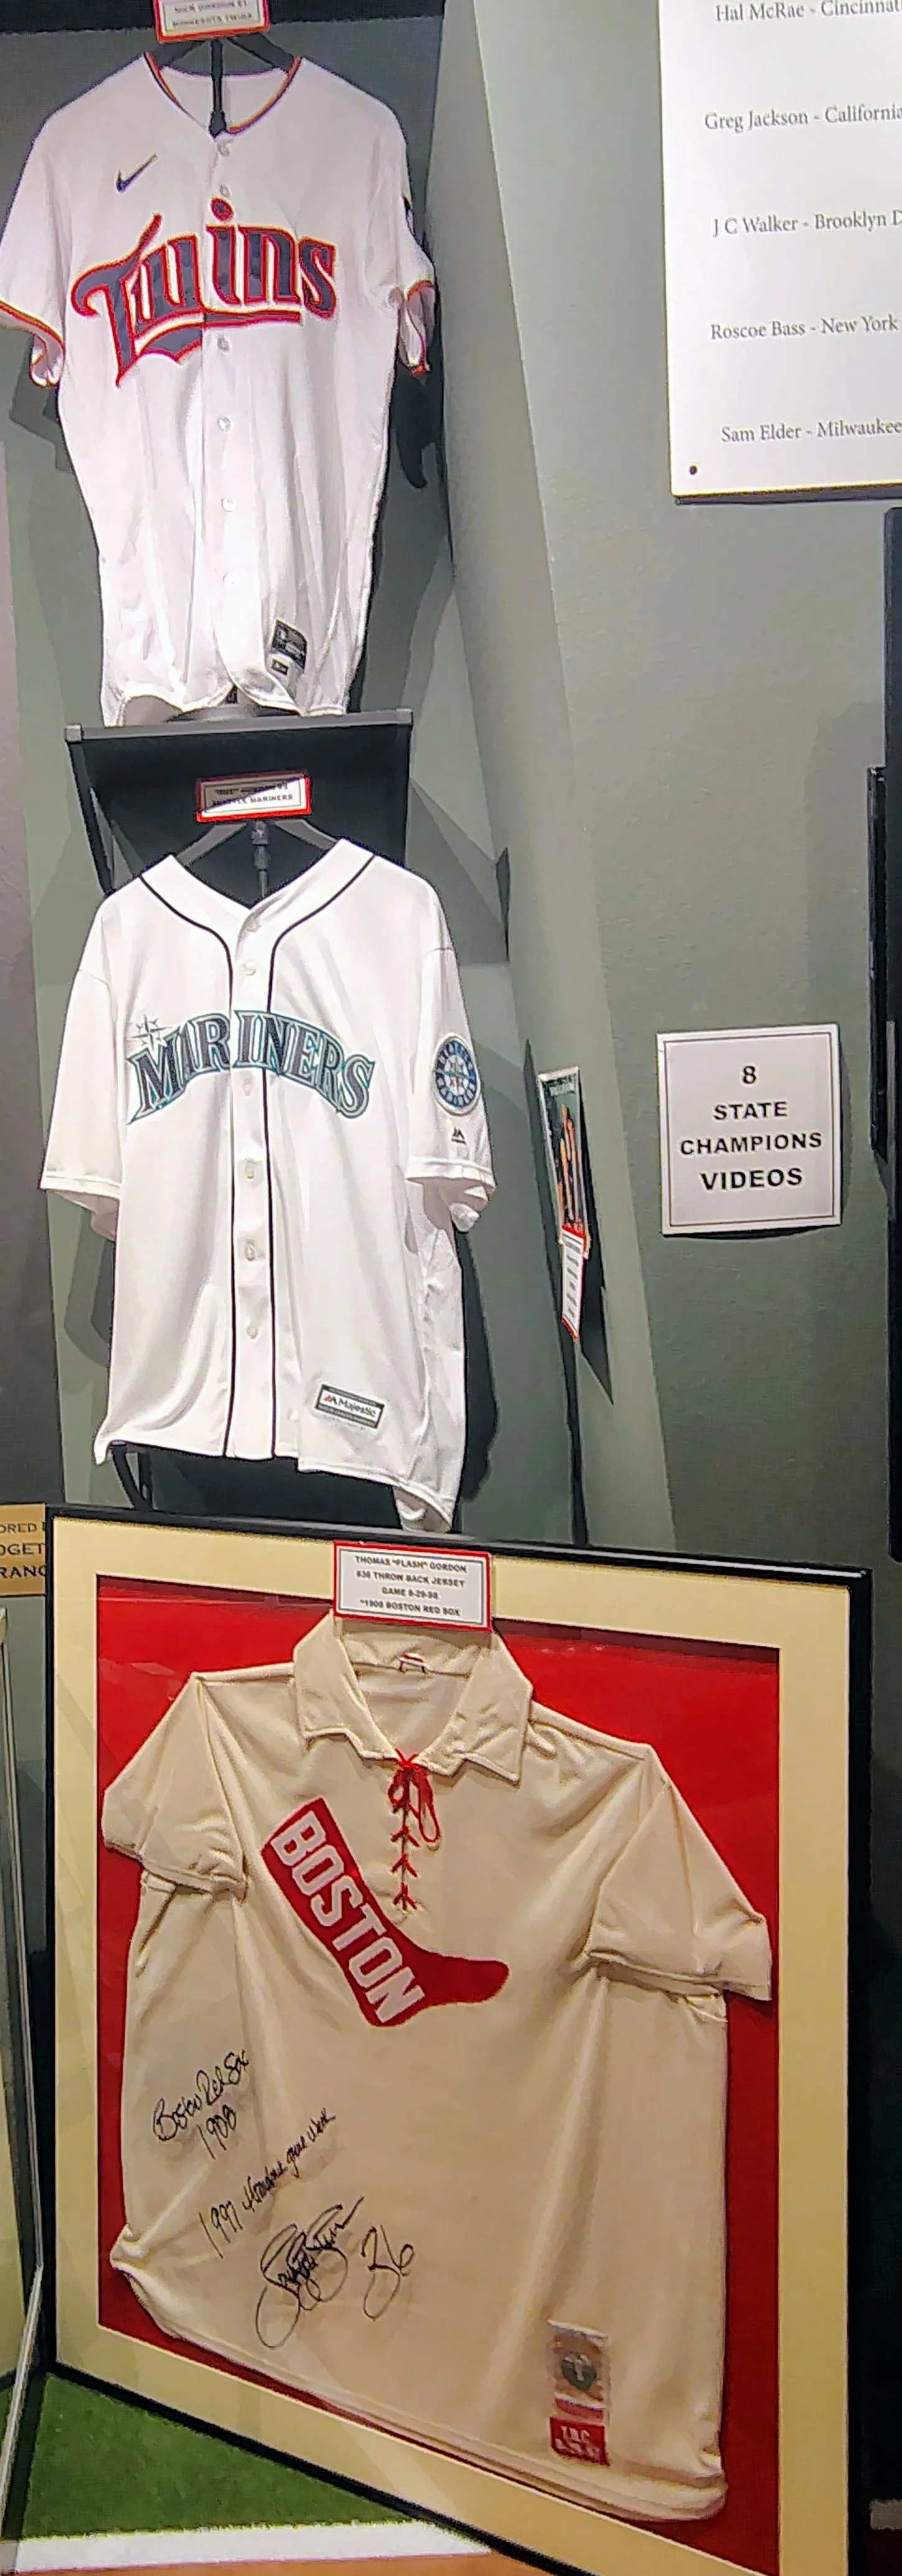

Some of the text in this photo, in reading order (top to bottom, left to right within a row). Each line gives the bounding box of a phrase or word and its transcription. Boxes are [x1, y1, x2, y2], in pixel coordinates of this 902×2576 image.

[715, 2, 744, 22] Hal
[749, 1, 805, 21] McRae
[704, 111, 744, 134] Greg
[748, 108, 808, 131] Jackson
[825, 103, 902, 124] California
[712, 218, 718, 239] J
[742, 213, 799, 233] Walker
[814, 208, 887, 233] Brooklyn
[70, 197, 338, 388] Twins
[710, 323, 767, 340] Roscoe
[769, 320, 806, 337] Bass
[821, 317, 858, 334] New
[861, 313, 899, 333] York
[721, 426, 755, 443] Sam
[759, 422, 802, 441] Elder
[816, 417, 902, 438] Milwaukee
[250, 793, 293, 804] MARINERS
[126, 1009, 376, 1125] MARINERS
[742, 1065, 757, 1085] 8
[713, 1101, 788, 1121] STATE
[681, 1132, 822, 1155] CHAMPIONS
[700, 1167, 803, 1191] VIDEOS
[355, 1555, 391, 1566] THOMAS
[429, 1562, 467, 1573] GORDON
[373, 1571, 403, 1582] THROW
[405, 1574, 429, 1584] BACK
[431, 1576, 465, 1587] JERSEY
[381, 1587, 406, 1597] GAME
[386, 1600, 421, 1612] BOSTON
[423, 1604, 440, 1615] RED
[442, 1607, 461, 1617] SOX
[270, 1809, 425, 2023] BOSTON
[196, 2104, 237, 2161] 1908
